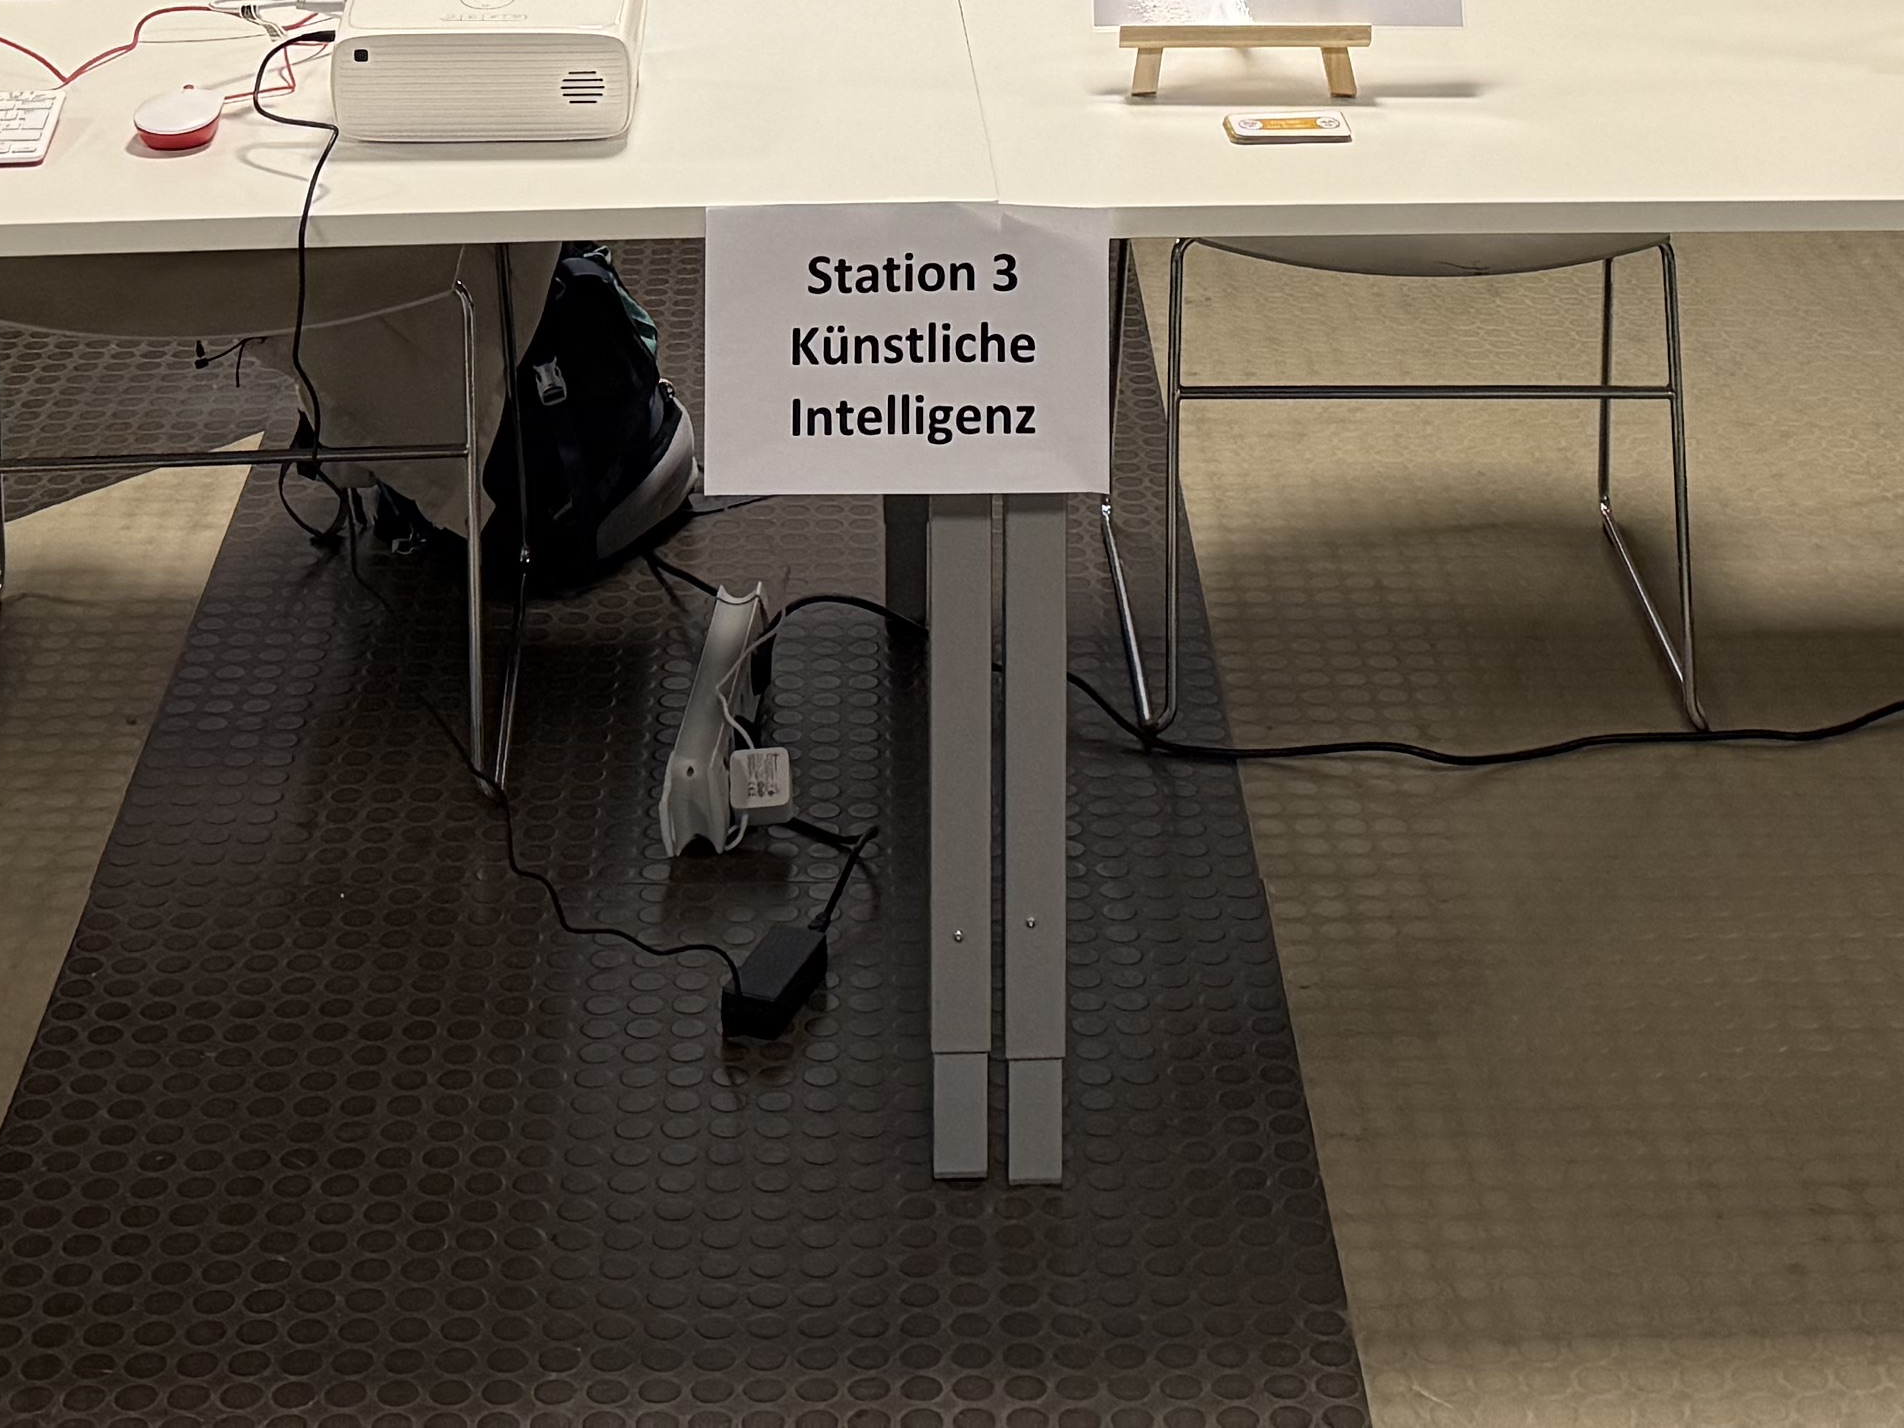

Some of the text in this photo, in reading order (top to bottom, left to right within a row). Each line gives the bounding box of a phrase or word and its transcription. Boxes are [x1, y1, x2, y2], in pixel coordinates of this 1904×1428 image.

[807, 252, 1018, 295] Station 3
[791, 321, 1036, 366] Künstliche
[791, 394, 1036, 445] Intelligenz
